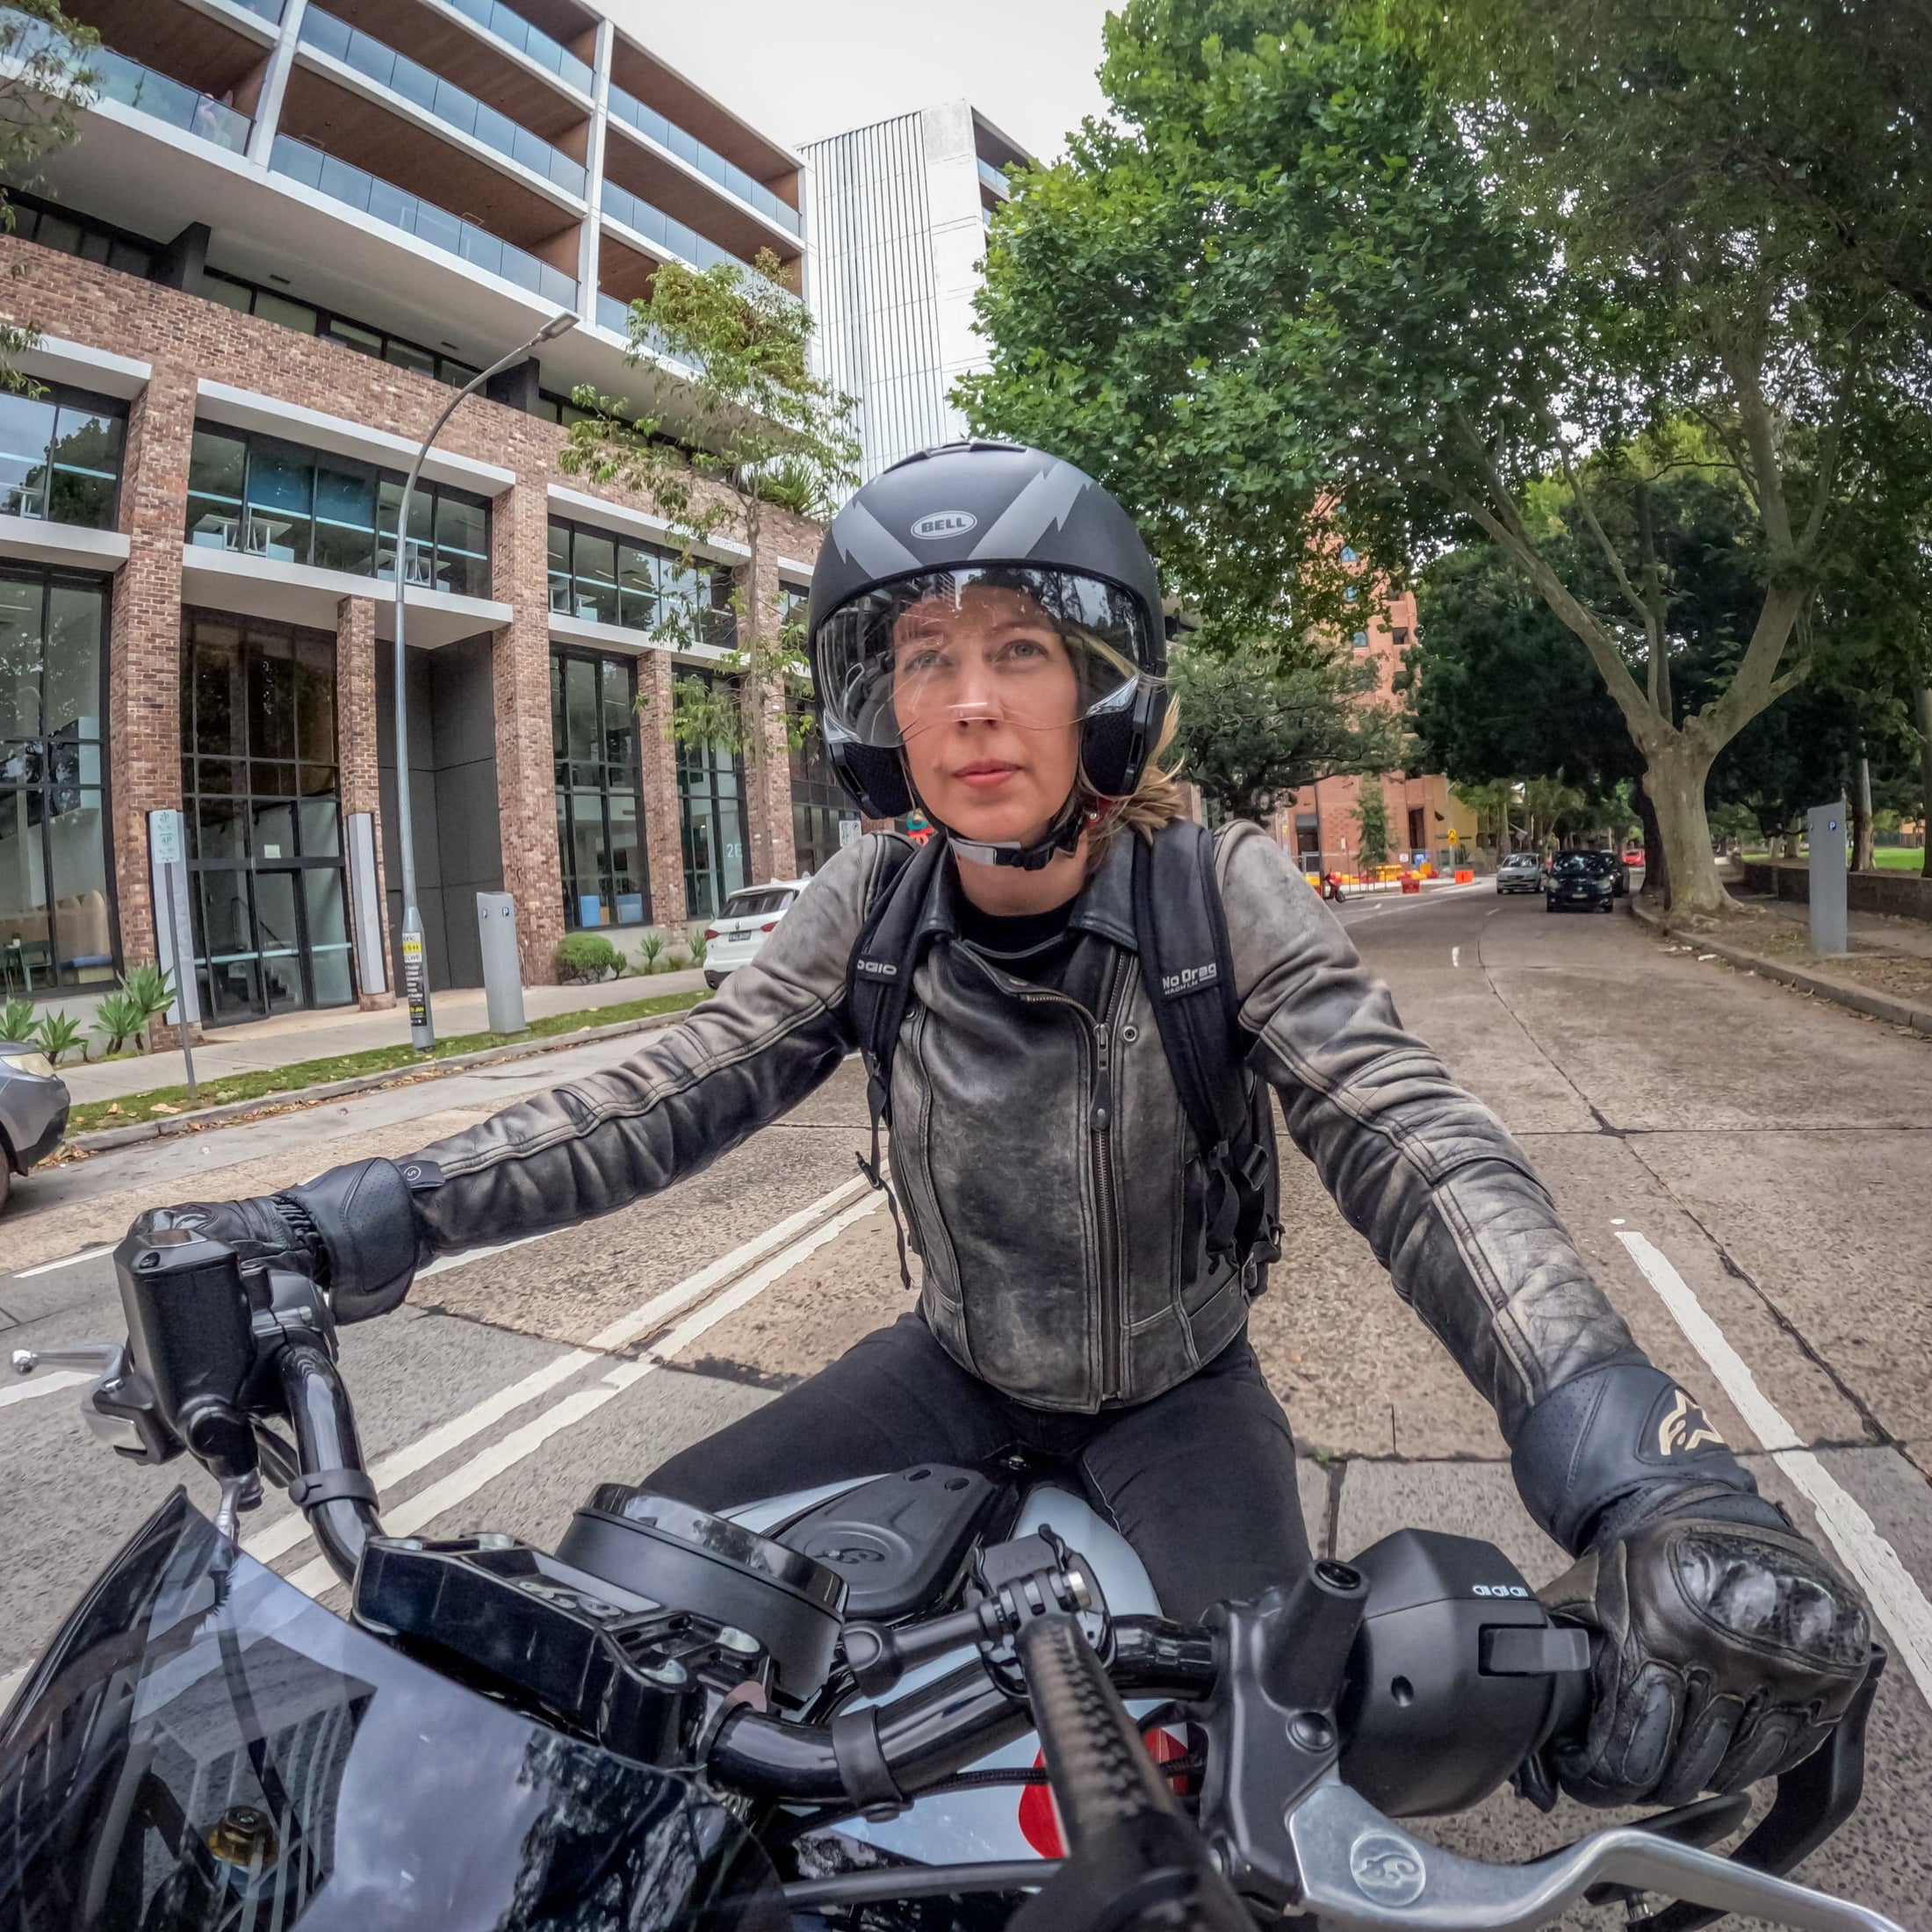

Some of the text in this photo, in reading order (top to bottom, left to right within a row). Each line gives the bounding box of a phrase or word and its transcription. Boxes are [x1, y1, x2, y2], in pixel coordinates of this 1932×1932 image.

[921, 517, 967, 533] BELL
[1162, 962, 1217, 990] No Drag
